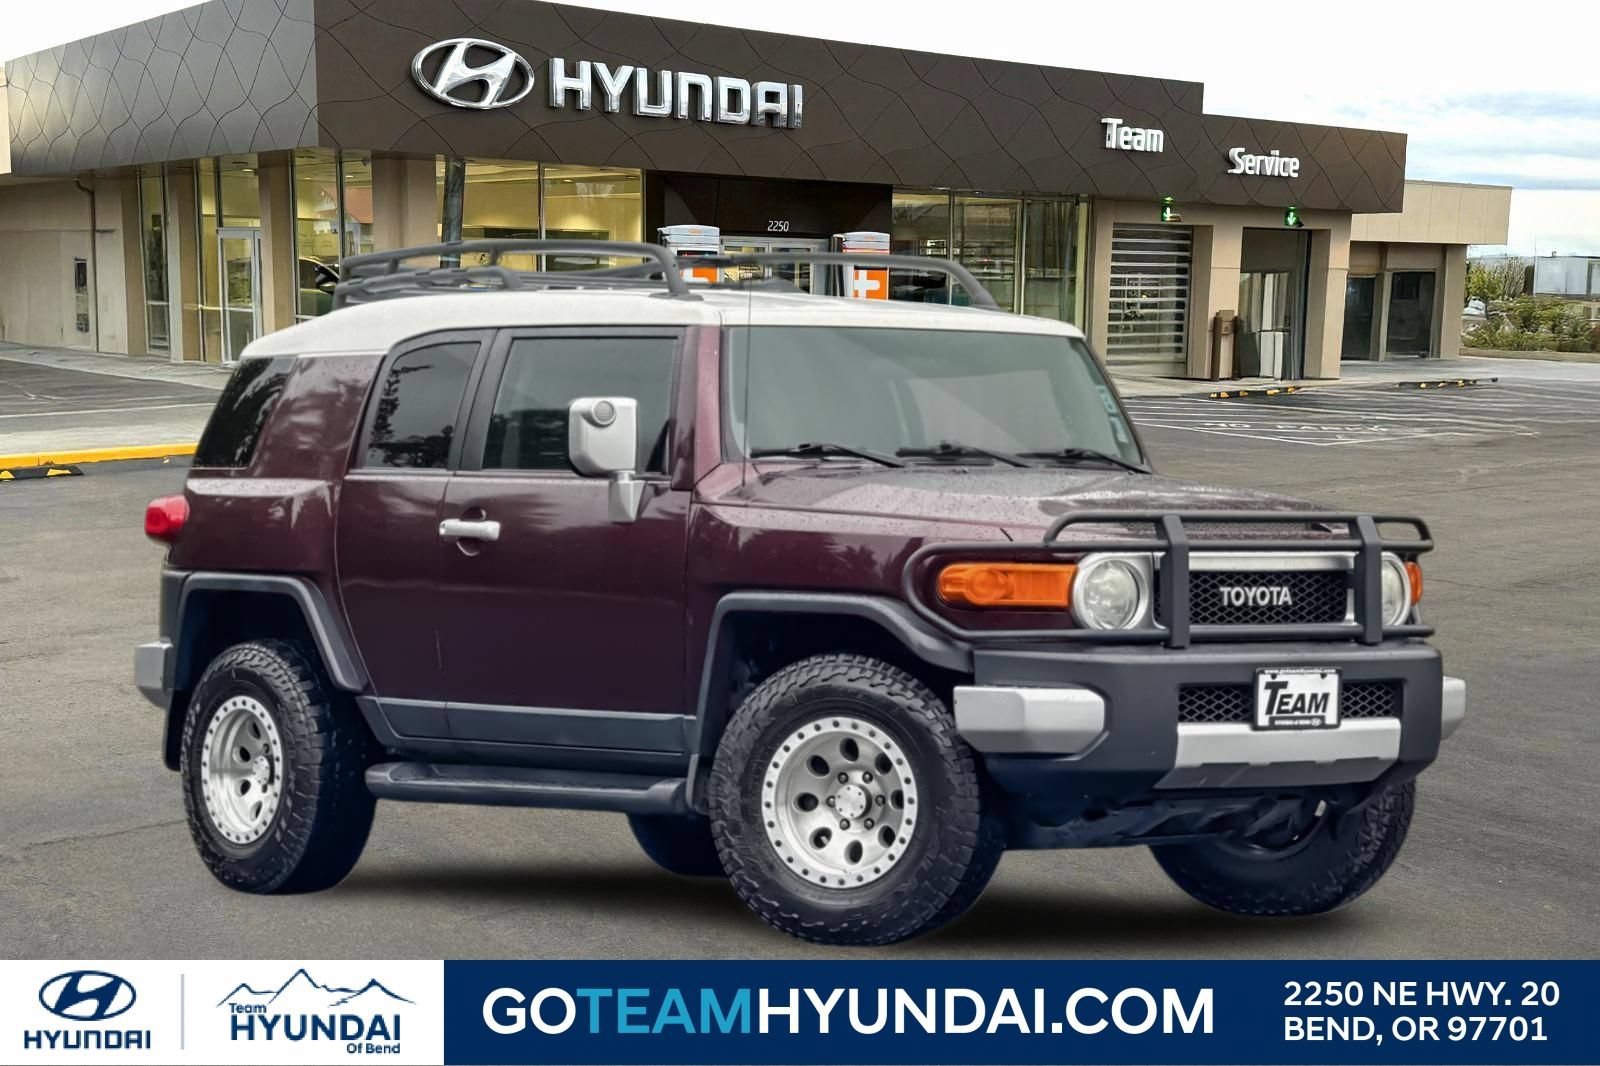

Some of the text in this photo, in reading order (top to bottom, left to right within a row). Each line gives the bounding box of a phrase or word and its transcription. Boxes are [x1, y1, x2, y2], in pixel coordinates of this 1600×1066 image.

[548, 57, 803, 129] HYUNDAI
[1101, 117, 1165, 153] Team
[1228, 147, 1300, 178] Service
[767, 220, 790, 232] 2250
[1220, 586, 1293, 606] TOYOTA
[1264, 681, 1330, 715] TEAM
